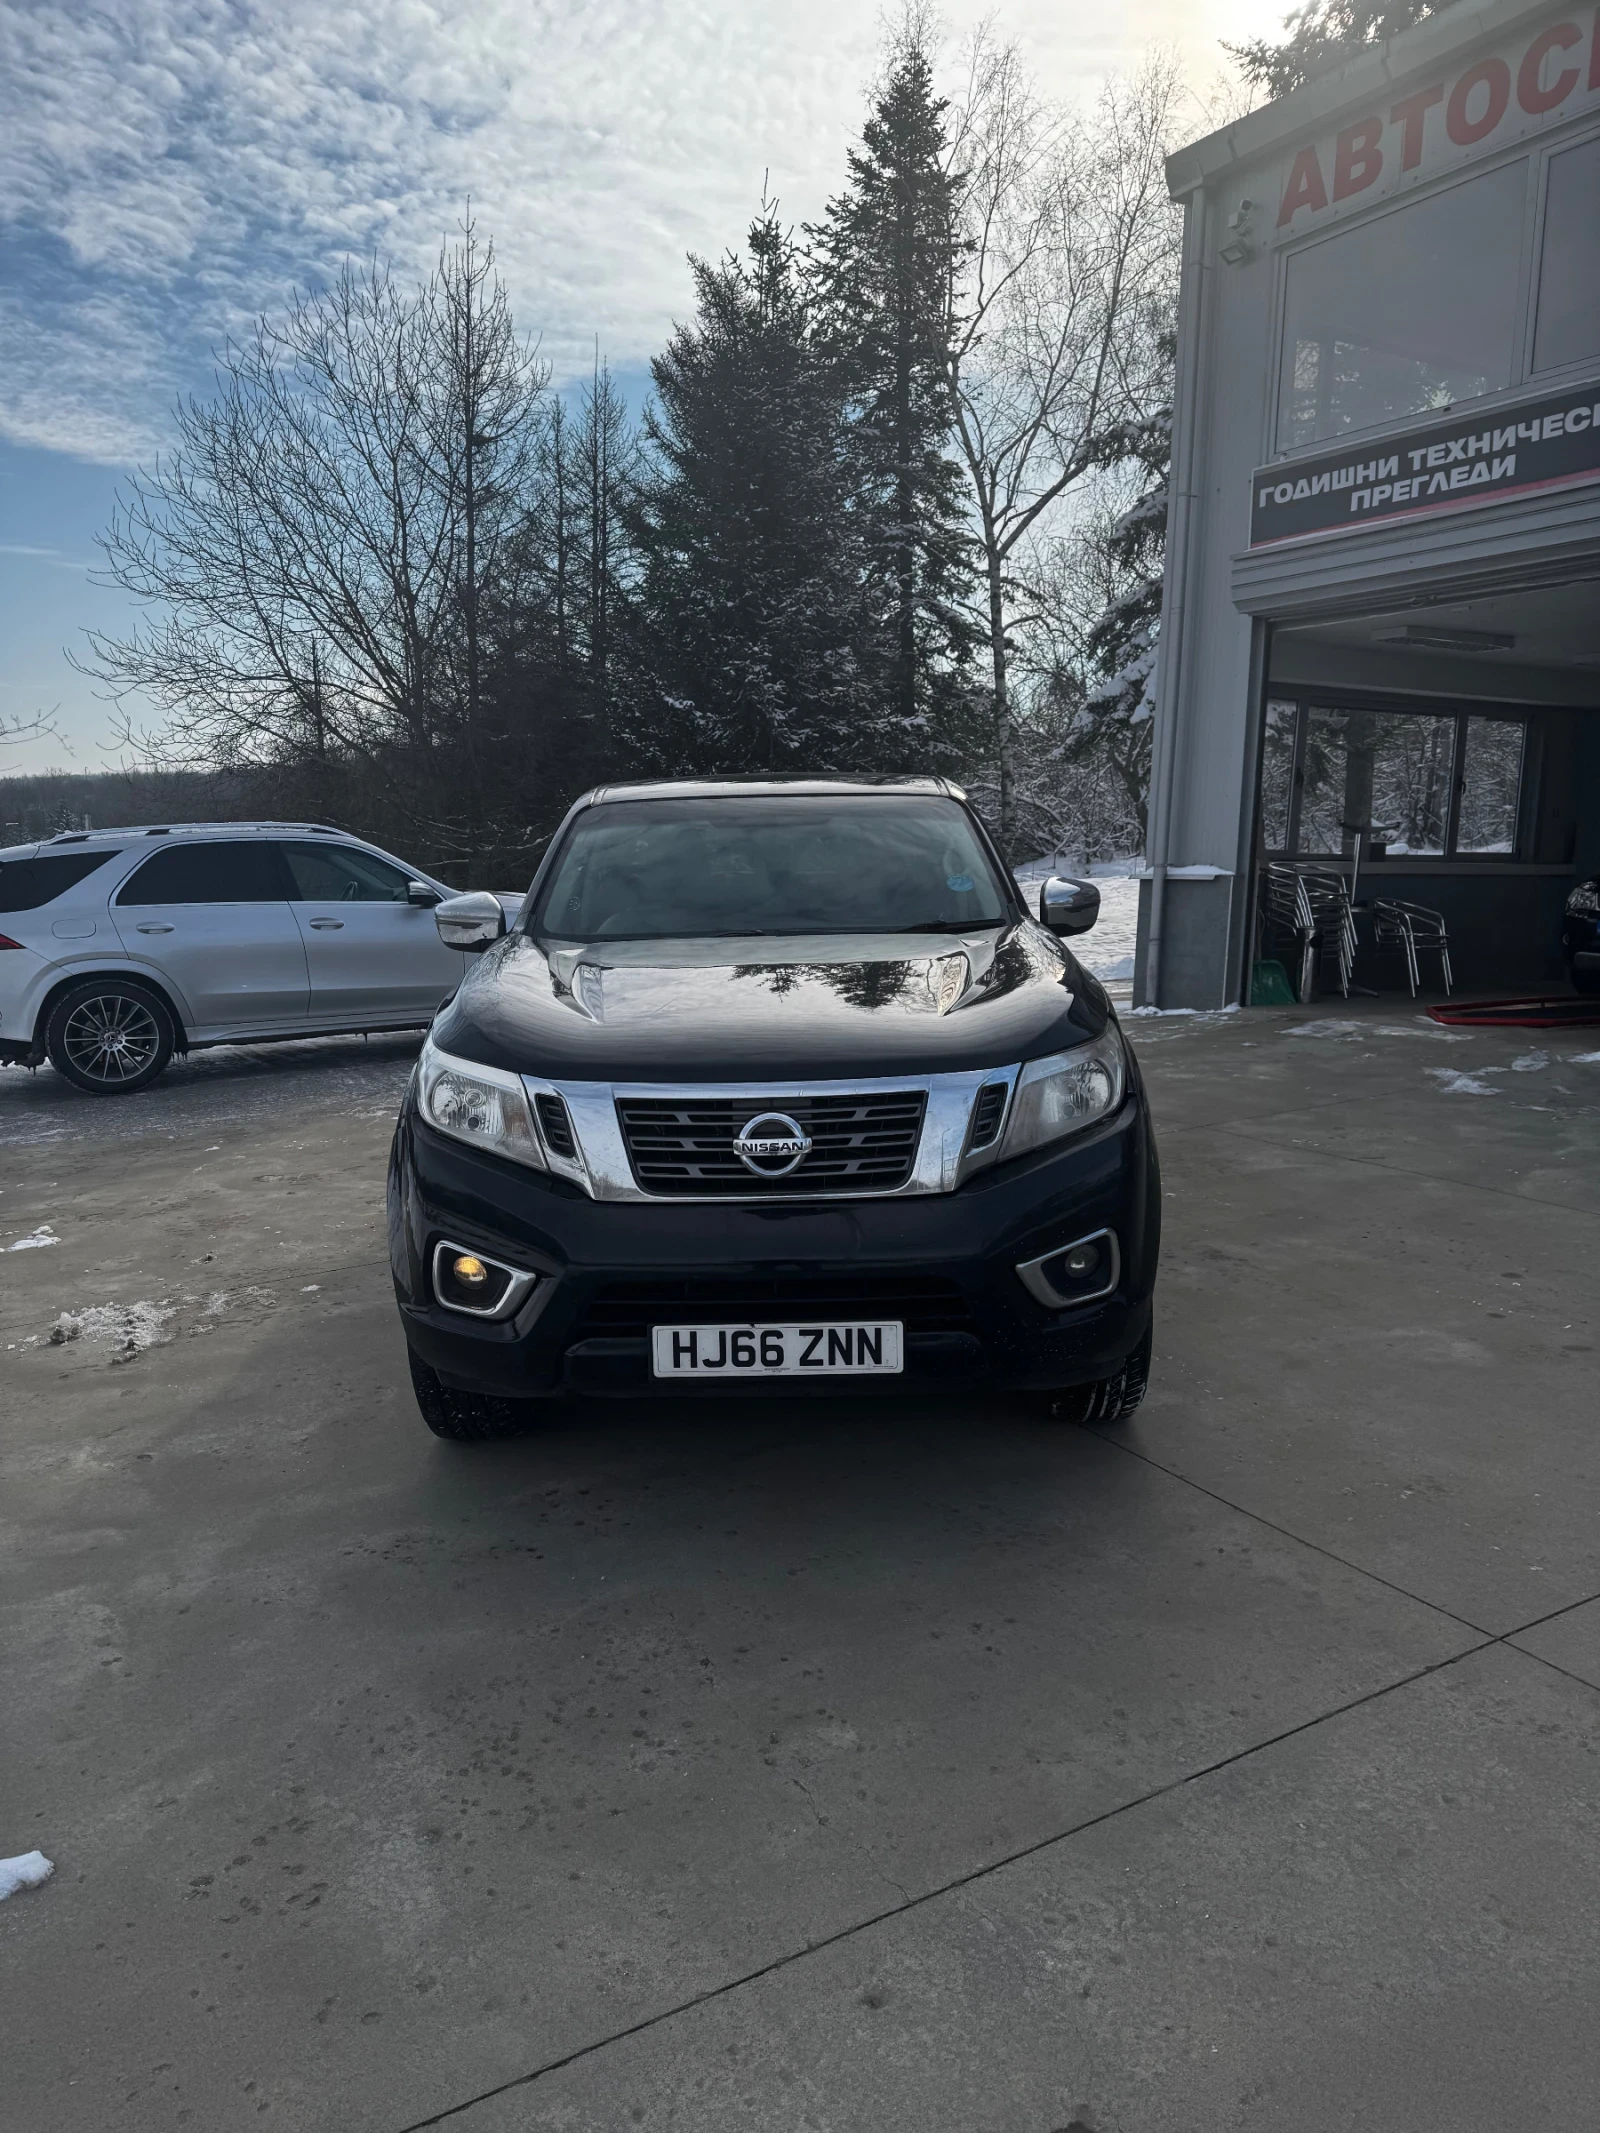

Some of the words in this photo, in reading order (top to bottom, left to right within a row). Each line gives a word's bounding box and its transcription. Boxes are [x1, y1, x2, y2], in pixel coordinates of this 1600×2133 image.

[1276, 6, 1600, 228] АВТОС
[1259, 455, 1399, 508] ГОДИШНИ
[1408, 403, 1600, 471] ТЕХНИЧЕС
[1350, 454, 1517, 512] ПРЕГЛЕДИ
[741, 1141, 804, 1153] NISSAN
[672, 1330, 784, 1369] HJ66
[798, 1327, 882, 1367] ZNN
